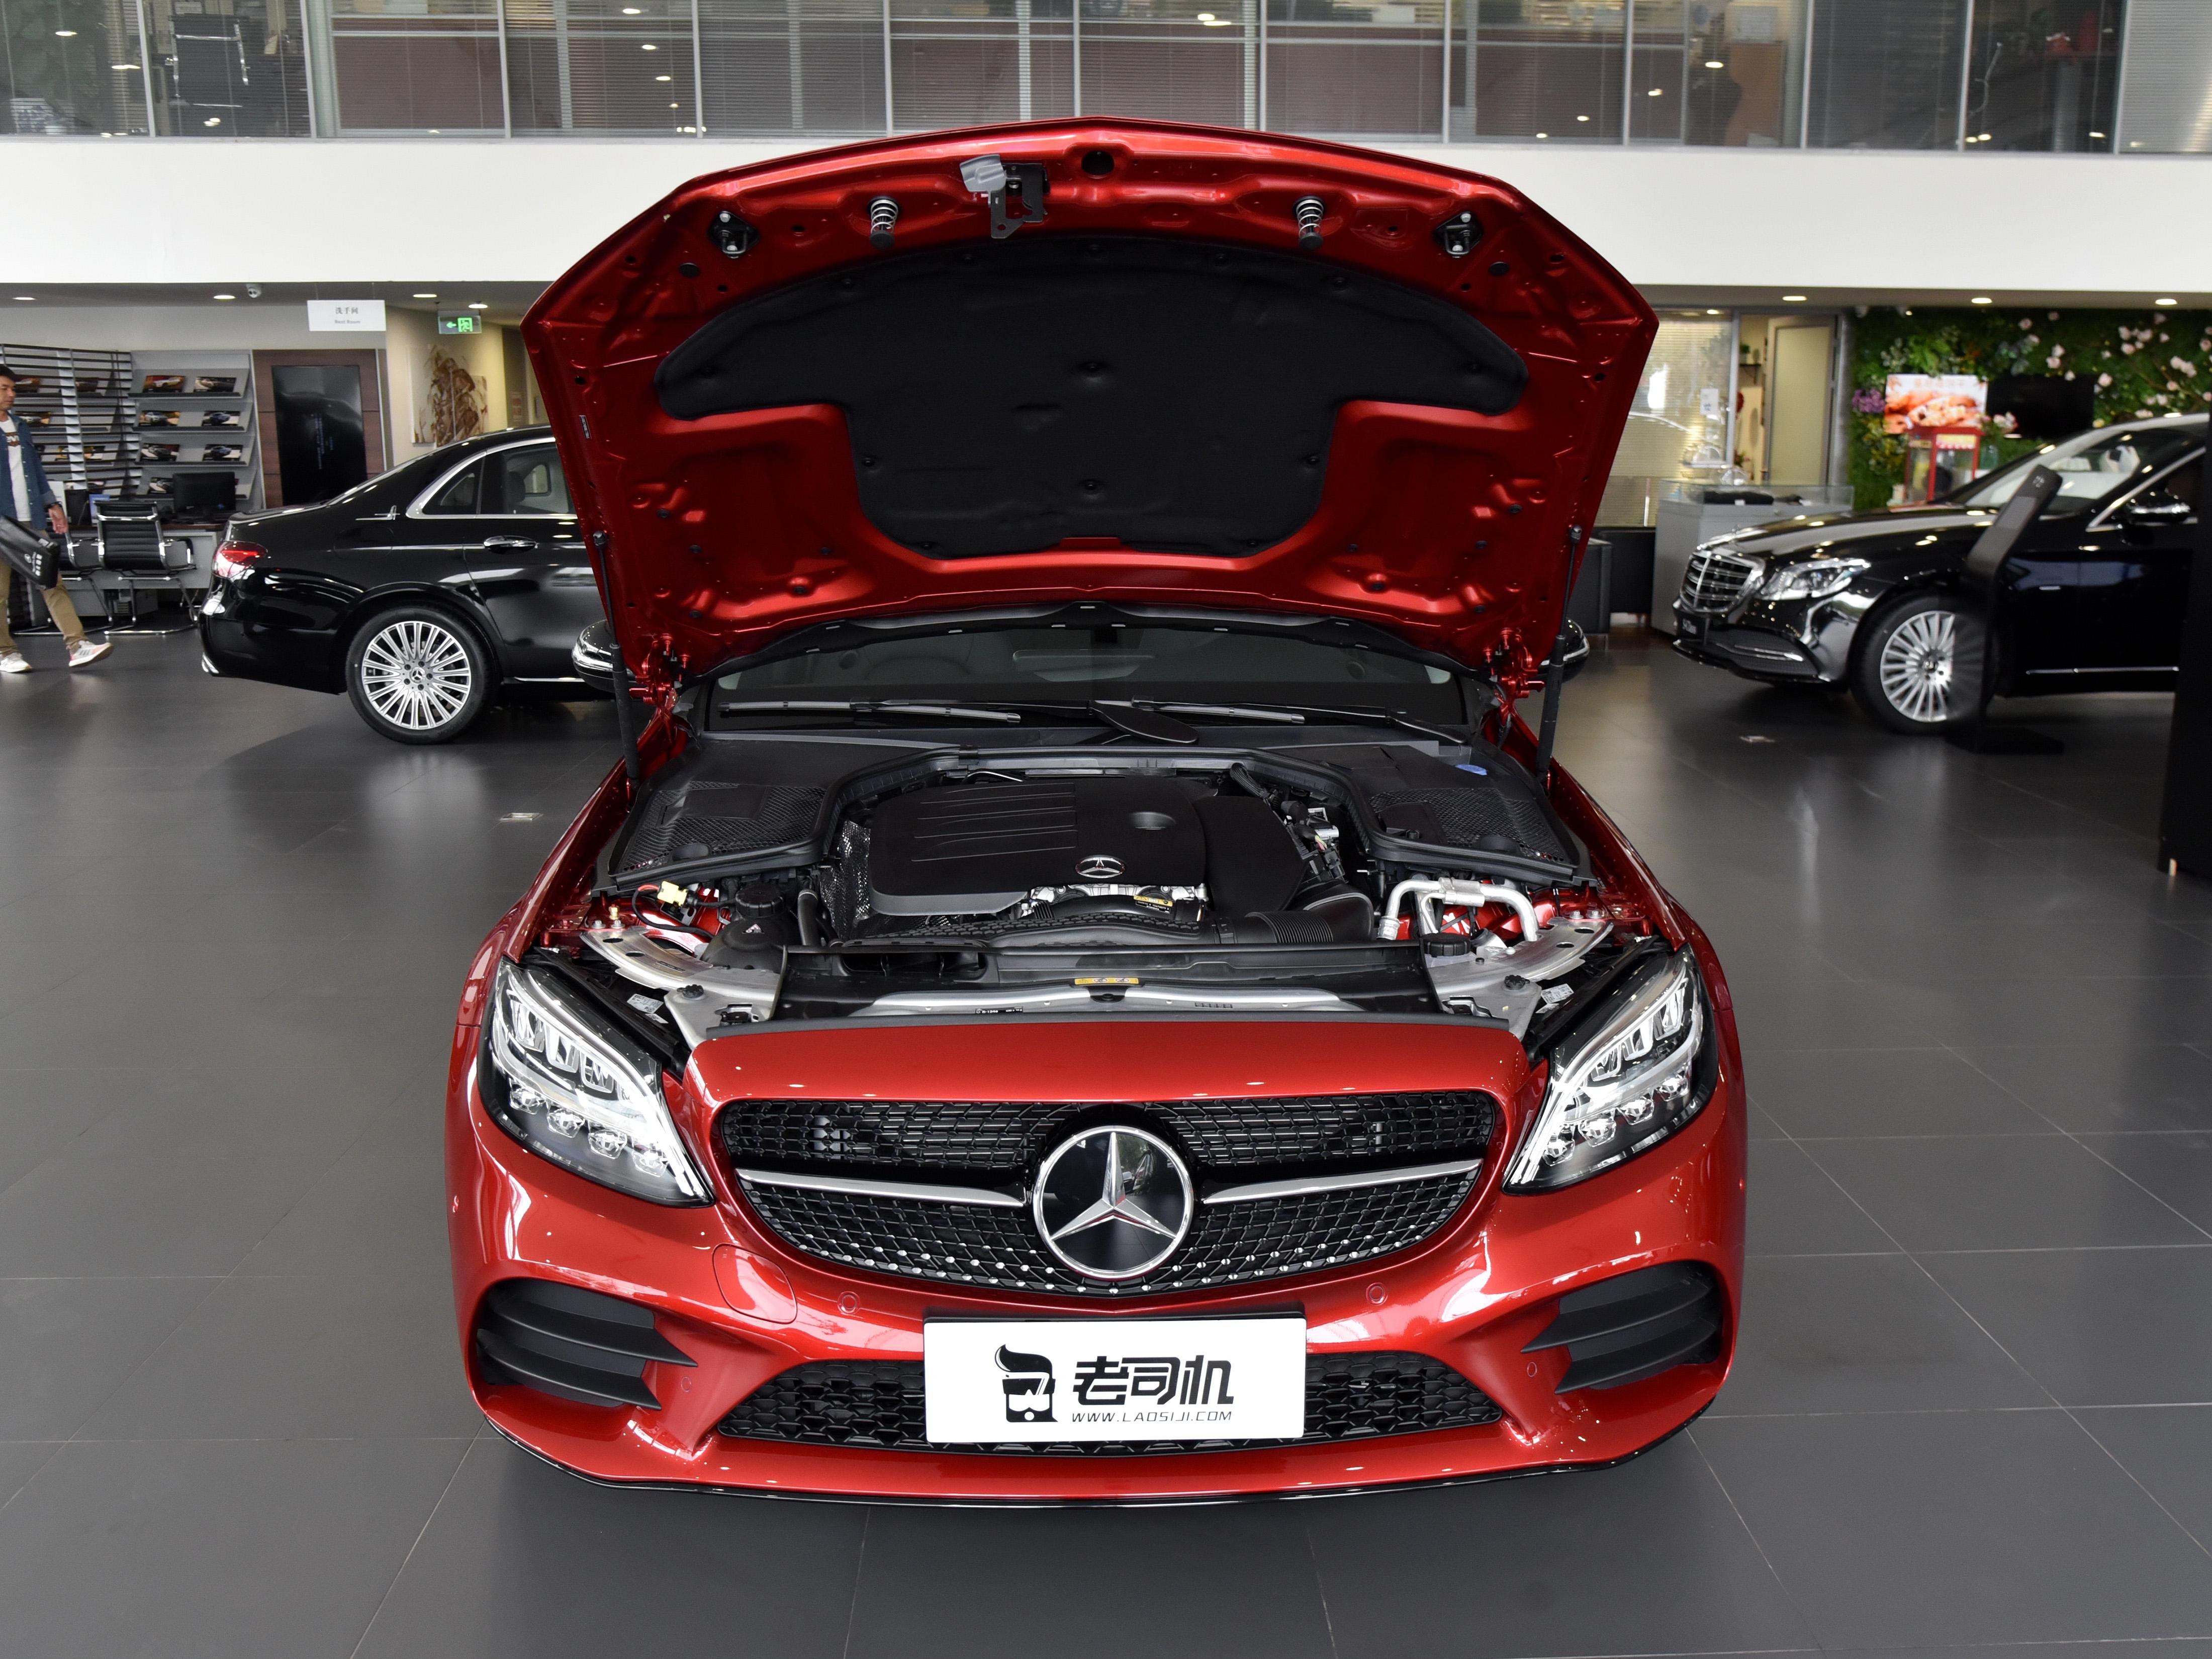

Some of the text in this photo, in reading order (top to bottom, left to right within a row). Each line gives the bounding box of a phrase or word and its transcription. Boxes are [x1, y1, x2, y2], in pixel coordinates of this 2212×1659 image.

[1073, 1355, 1234, 1406] 老司机
[1072, 1411, 1232, 1422] WWW.LAOSIJI.COM
